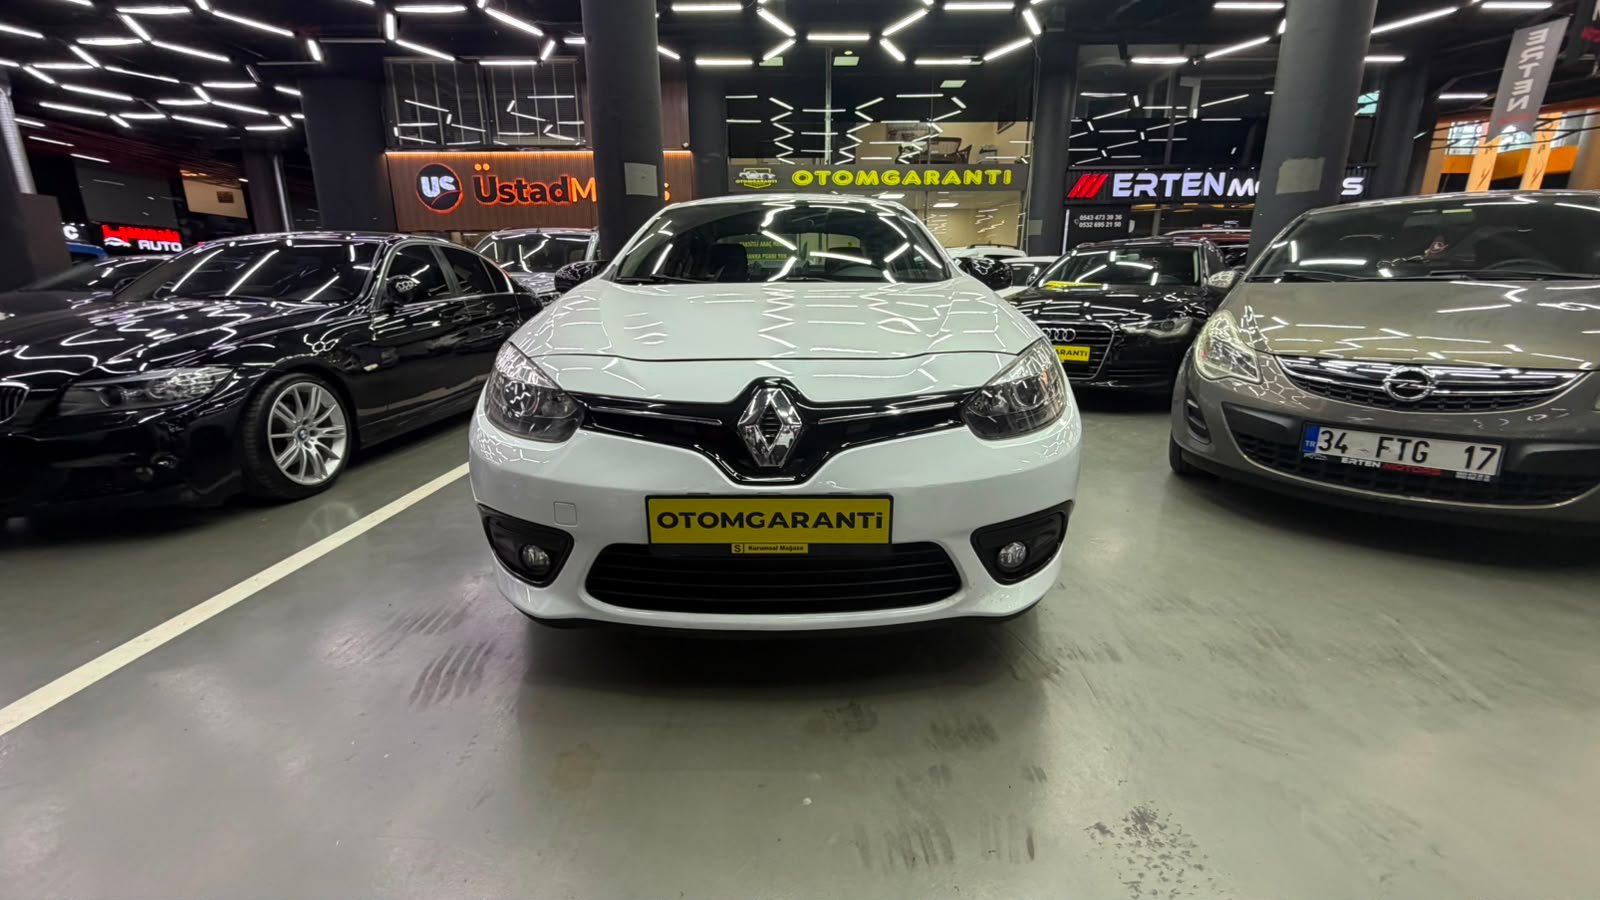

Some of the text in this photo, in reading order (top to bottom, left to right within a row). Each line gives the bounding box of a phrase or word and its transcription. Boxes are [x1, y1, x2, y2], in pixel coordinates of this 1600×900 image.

[792, 169, 1012, 186] OTOMGARANTI
[1112, 172, 1226, 197] ERTEN
[138, 239, 182, 252] AUTO
[1304, 440, 1316, 448] TR
[1318, 430, 1498, 471] 34 FTG 17
[1341, 457, 1381, 468] ERTEN
